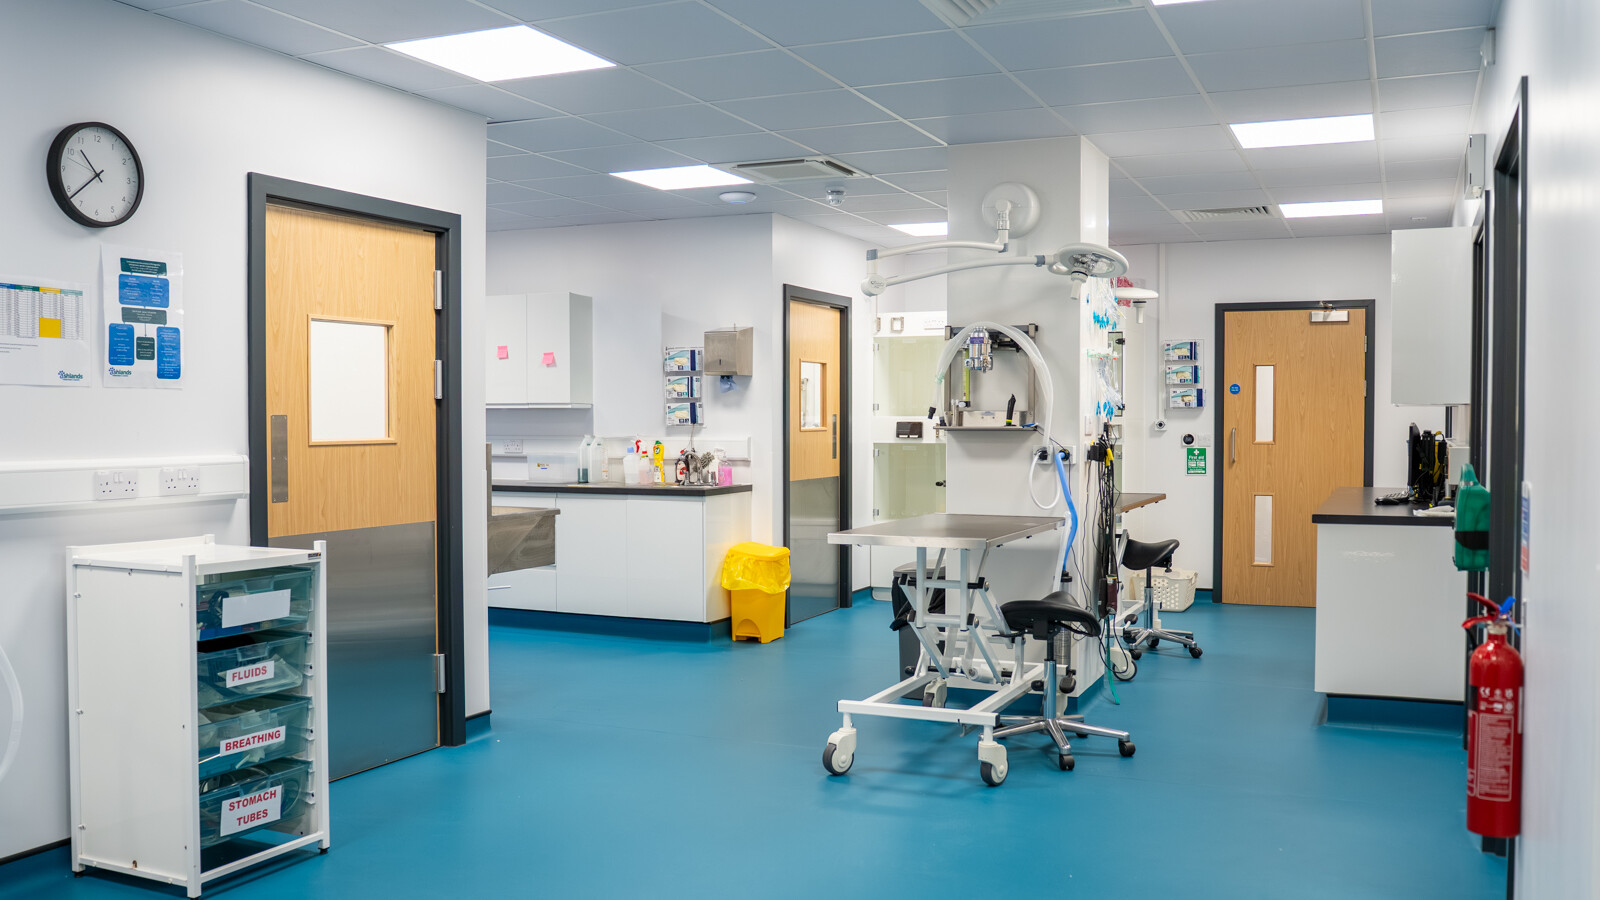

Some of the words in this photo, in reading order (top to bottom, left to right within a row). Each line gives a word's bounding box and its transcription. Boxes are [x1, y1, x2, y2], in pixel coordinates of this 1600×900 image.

[77, 136, 84, 144] 11
[93, 134, 101, 143] 12
[67, 147, 74, 156] 10
[232, 665, 267, 682] FLUIDS
[225, 729, 281, 752] BREATHING
[228, 789, 277, 812] STOMACH
[236, 808, 268, 827] TUBES
